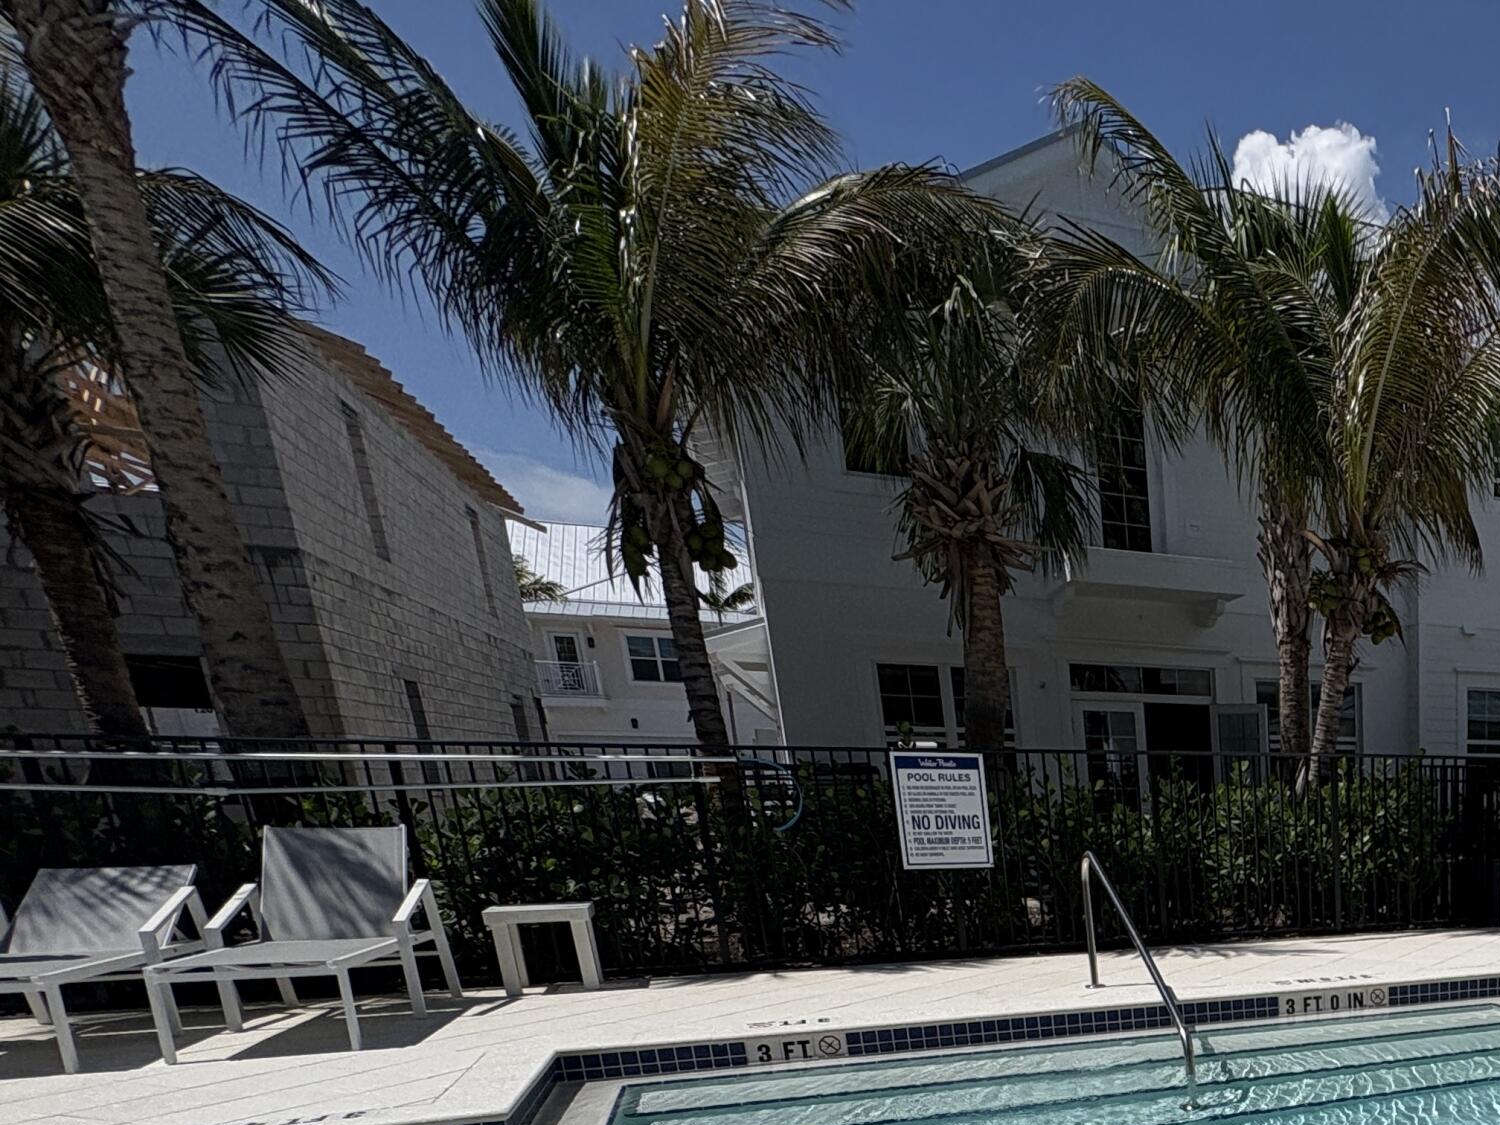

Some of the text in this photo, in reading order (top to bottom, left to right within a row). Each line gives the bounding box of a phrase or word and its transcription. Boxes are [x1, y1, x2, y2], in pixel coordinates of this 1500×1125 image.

[907, 773, 971, 782] POOL RULES
[911, 814, 980, 830] NO DIVING
[913, 837, 926, 845] POOL
[927, 837, 950, 845] MAXIMUM
[971, 836, 982, 844] FEET
[1286, 998, 1295, 1014] 3
[1330, 994, 1339, 1010] 0
[757, 1040, 813, 1062] 3 FT.
